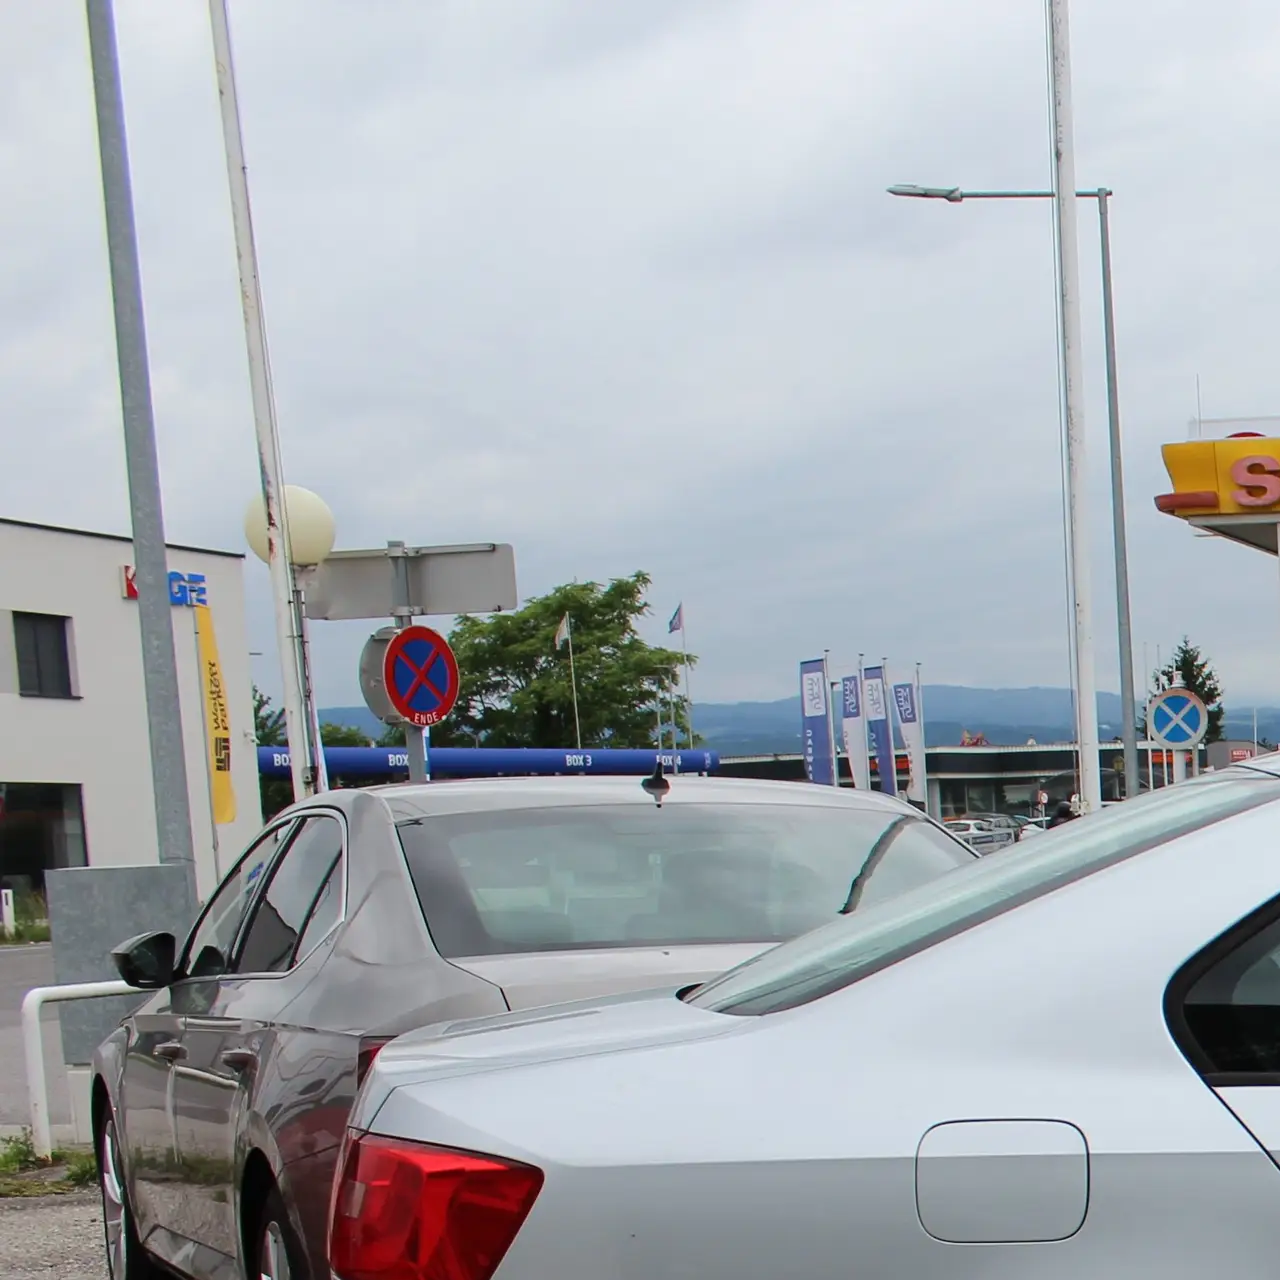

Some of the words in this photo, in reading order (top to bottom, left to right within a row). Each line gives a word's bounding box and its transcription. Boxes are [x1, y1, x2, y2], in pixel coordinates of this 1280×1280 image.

[414, 712, 440, 724] ENDE
[566, 754, 584, 767] BOX
[586, 755, 592, 767] 3
